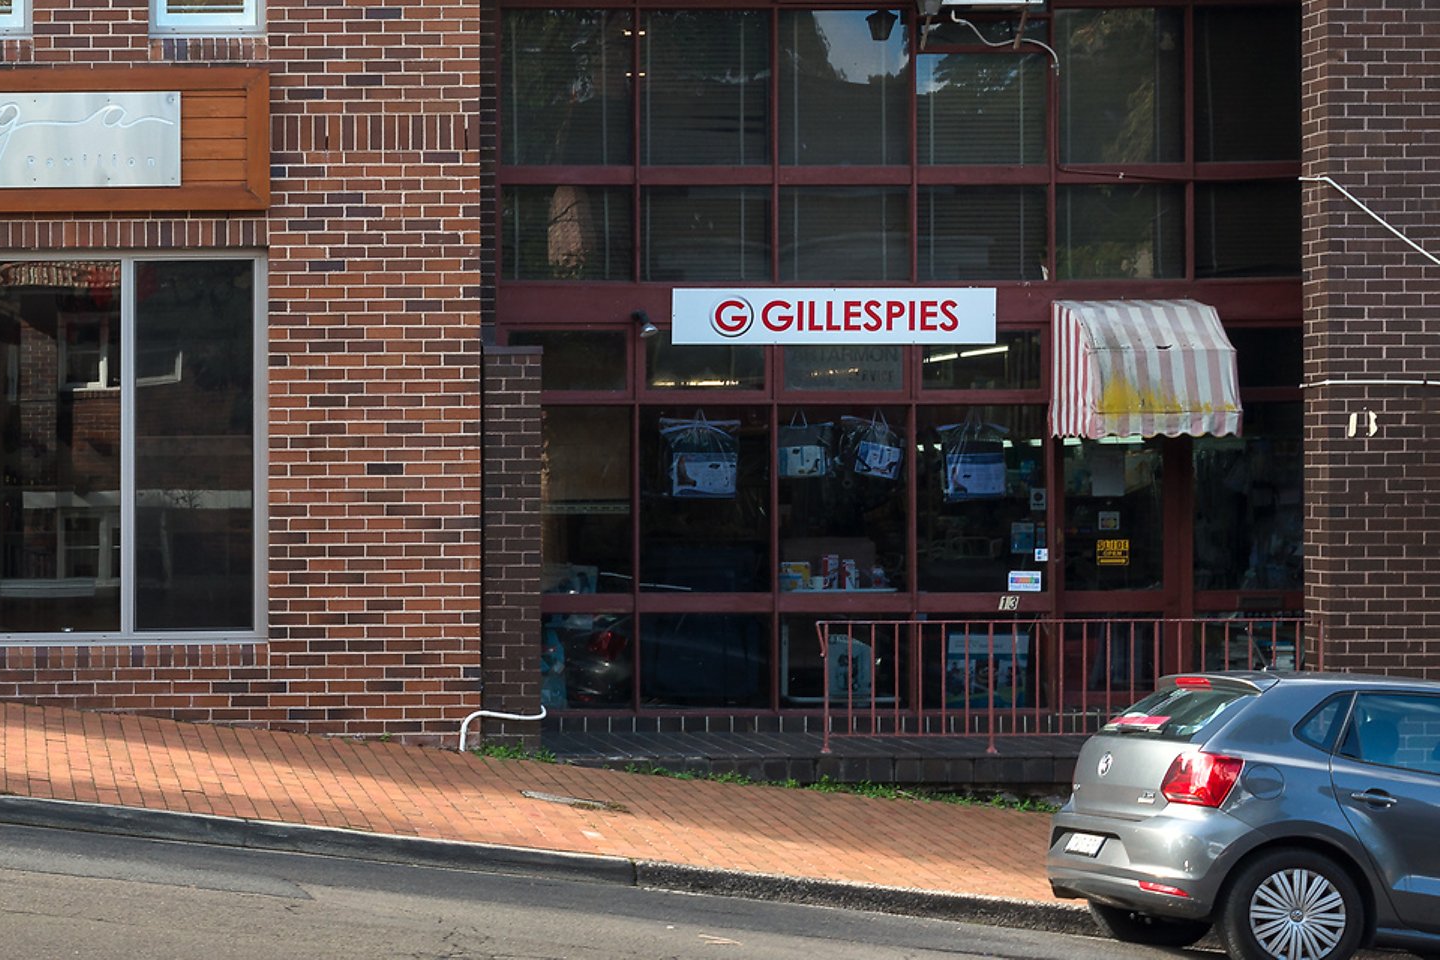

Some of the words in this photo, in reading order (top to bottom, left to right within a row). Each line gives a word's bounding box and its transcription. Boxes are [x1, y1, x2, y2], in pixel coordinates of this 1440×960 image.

[761, 300, 959, 332] GILLESPIES
[1097, 539, 1129, 551] SLIDE
[1000, 596, 1019, 610] 13
